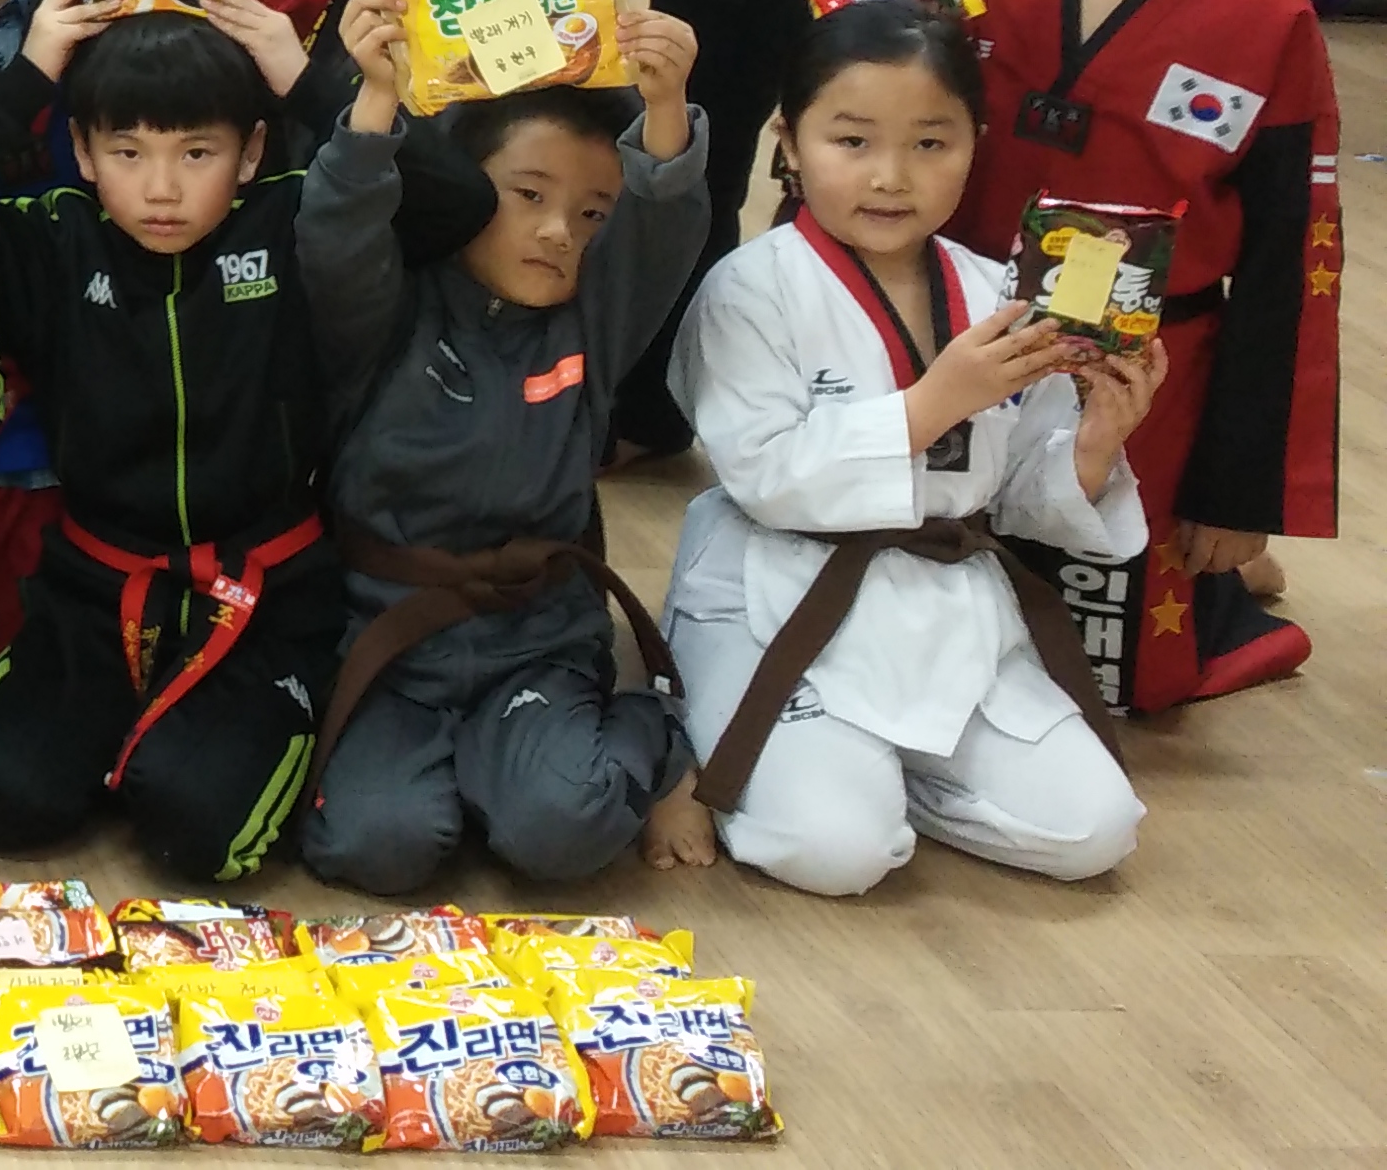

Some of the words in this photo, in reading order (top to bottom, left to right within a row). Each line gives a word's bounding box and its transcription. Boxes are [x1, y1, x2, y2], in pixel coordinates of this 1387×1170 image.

[215, 248, 268, 284] 1967
[224, 280, 275, 300] KAPPA
[201, 1022, 343, 1072] 진라면
[397, 1016, 542, 1076] 진라면
[589, 1002, 732, 1053] 진라면
[506, 1063, 555, 1086] 순한맛
